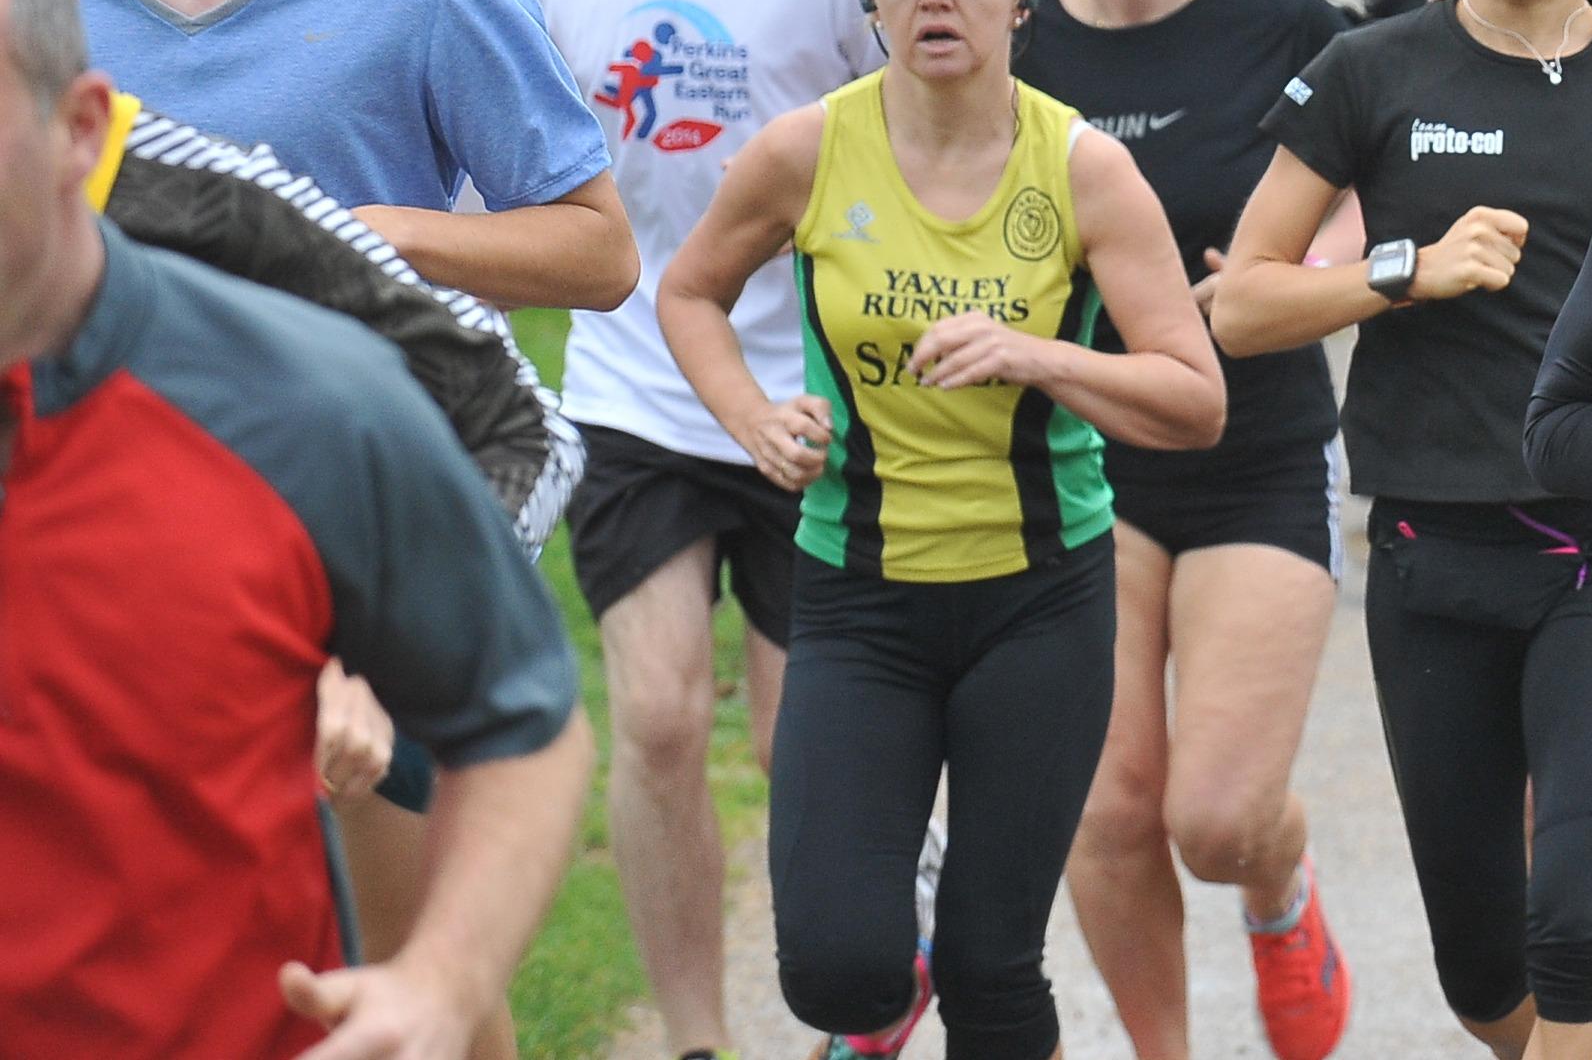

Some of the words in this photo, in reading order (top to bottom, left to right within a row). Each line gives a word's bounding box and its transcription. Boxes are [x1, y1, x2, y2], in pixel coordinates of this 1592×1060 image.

[688, 61, 749, 79] Great
[674, 81, 751, 100] Eastern
[886, 268, 1011, 300] YAXLEY
